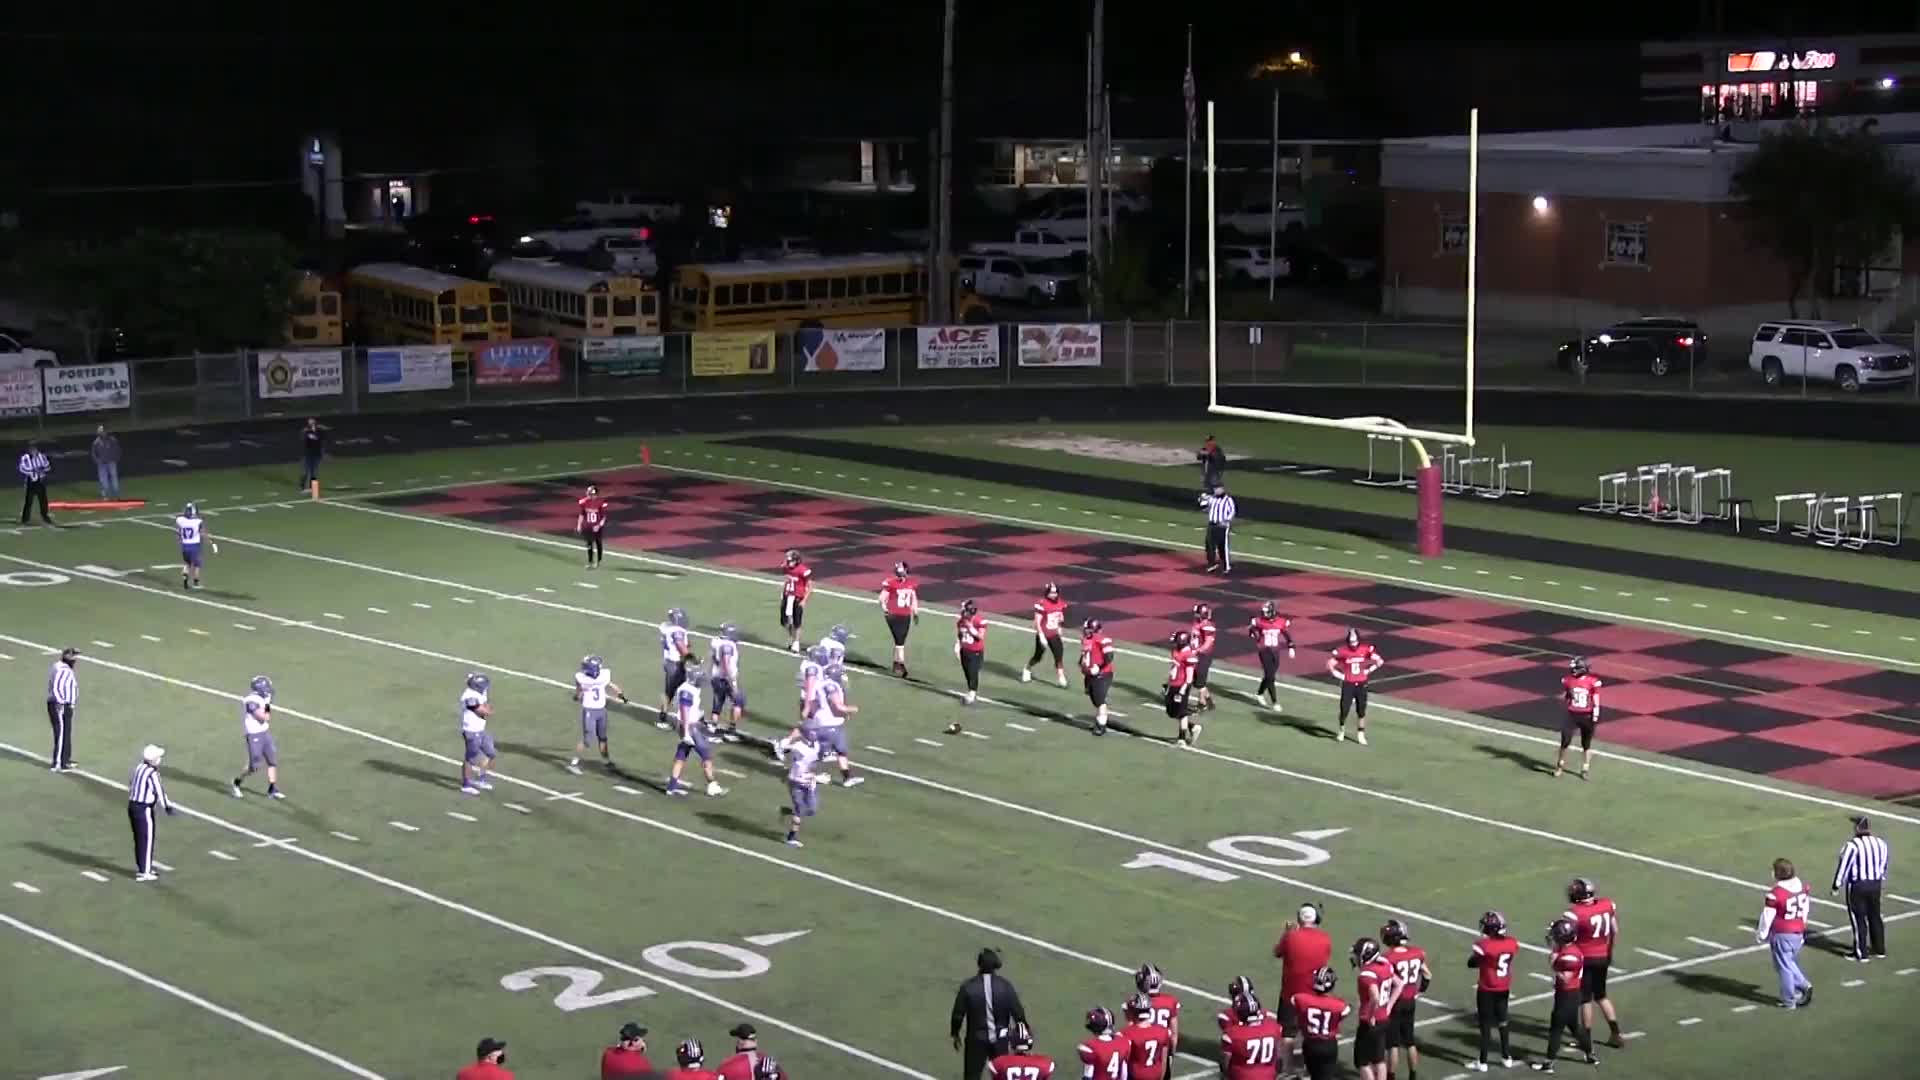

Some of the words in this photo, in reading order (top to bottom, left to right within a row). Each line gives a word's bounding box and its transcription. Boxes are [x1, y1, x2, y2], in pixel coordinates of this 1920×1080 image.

[928, 328, 992, 344] ACE
[928, 343, 988, 352] Hardware
[48, 384, 79, 396] TOOL
[83, 380, 128, 393] WORLD
[592, 688, 600, 702] 3
[1121, 835, 1331, 882] 10
[1590, 913, 1610, 938] 71
[500, 940, 770, 1011] 20
[1397, 959, 1421, 985] 33
[1497, 954, 1511, 977] 5
[1307, 1008, 1331, 1035] 51
[1145, 1040, 1157, 1066] 7
[1246, 1037, 1275, 1064] 70
[1107, 1051, 1119, 1078] 4
